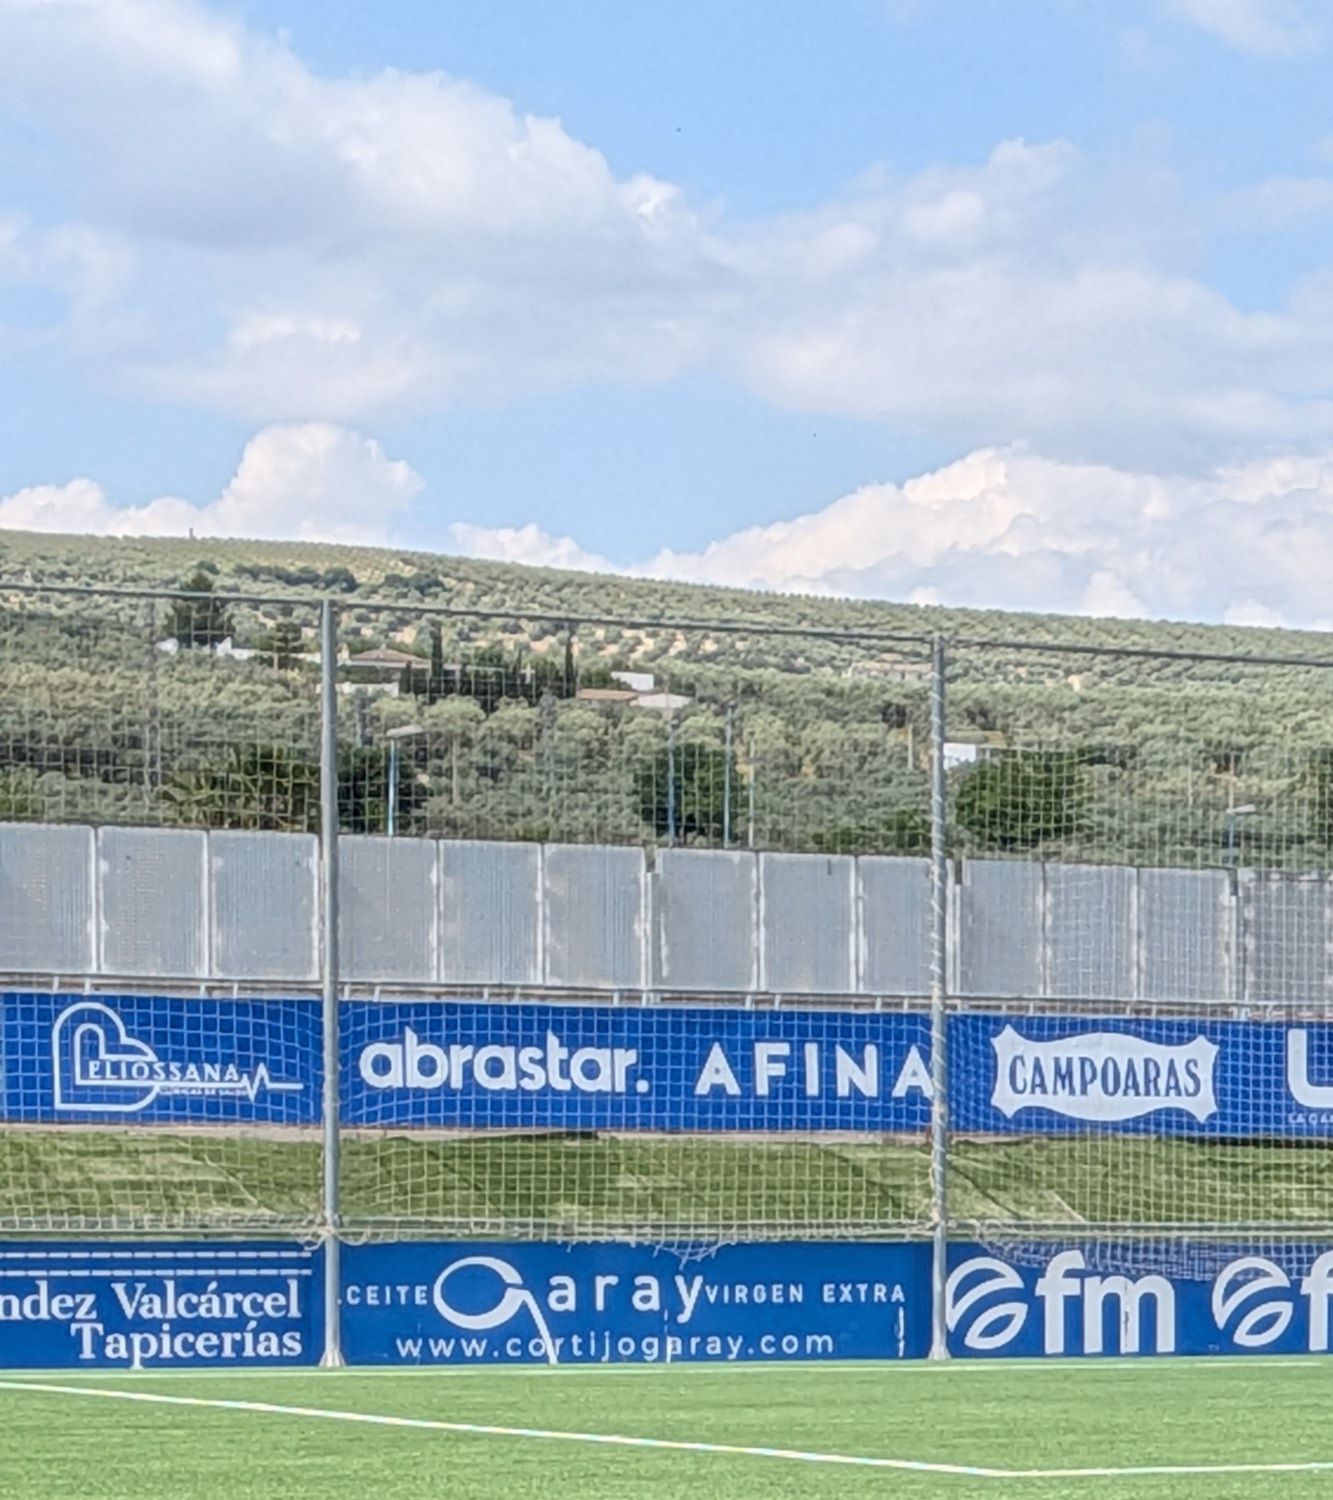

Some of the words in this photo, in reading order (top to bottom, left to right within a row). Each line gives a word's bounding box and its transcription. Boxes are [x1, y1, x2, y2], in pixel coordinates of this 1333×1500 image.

[694, 1041, 935, 1098] AFINA
[1008, 1054, 1201, 1098] CAMPOARAS
[111, 1279, 302, 1320] Valcárcel
[337, 1285, 428, 1305] CEITE
[705, 1284, 803, 1303] VIRGEN
[823, 1284, 906, 1303] EXTRA
[70, 1321, 303, 1369] Tapicerías
